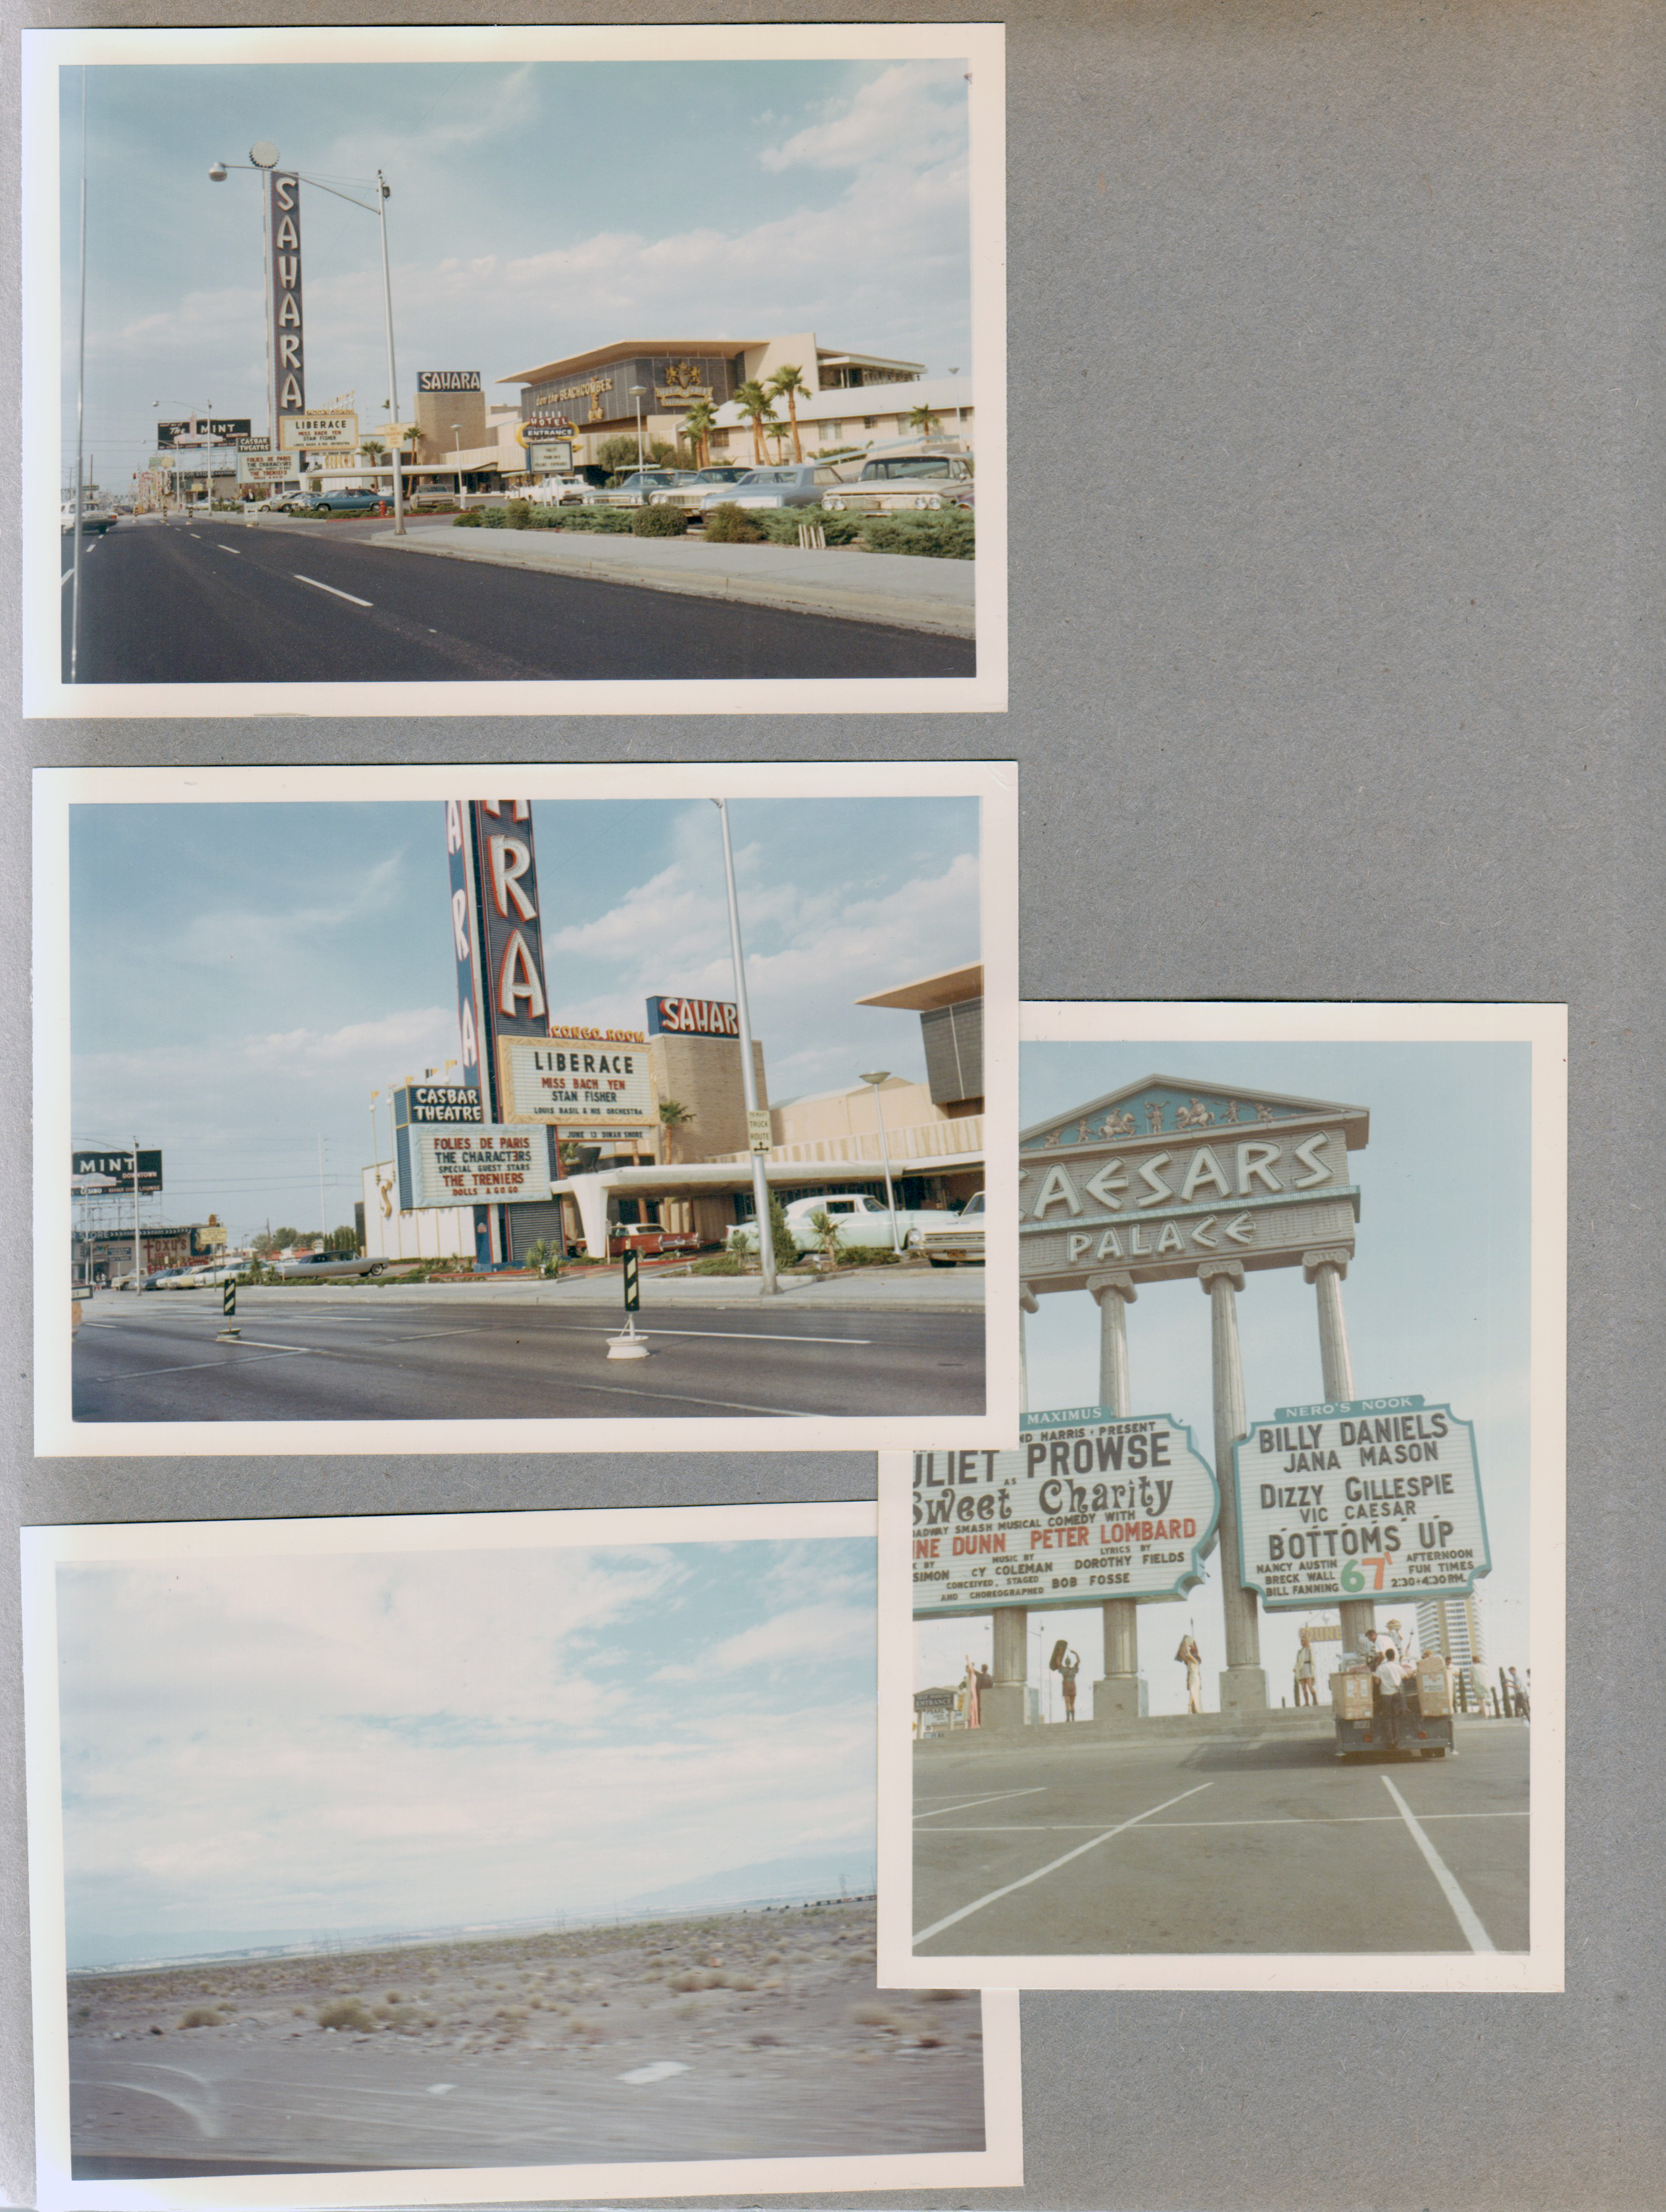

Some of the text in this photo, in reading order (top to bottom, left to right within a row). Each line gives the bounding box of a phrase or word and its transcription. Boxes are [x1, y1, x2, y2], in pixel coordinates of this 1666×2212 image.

[275, 177, 303, 409] SAHARA
[421, 372, 480, 390] SAHARA
[560, 378, 612, 401] BEACHCOMBER
[201, 424, 235, 433] MINT
[296, 420, 346, 429] LIBERACE
[531, 417, 567, 426] HOTEL
[551, 1025, 645, 1043] CONGO ROOM
[535, 1052, 633, 1074] LIBERACE
[542, 1077, 625, 1090] MISS BACH YEN
[416, 1089, 478, 1104] CASBAR
[552, 1091, 616, 1102] STAN FISHER
[413, 1106, 481, 1121] THEATRE
[434, 1137, 529, 1150] FOLIES DE PARIS
[80, 1158, 135, 1173] MINT
[435, 1152, 456, 1164] THE
[439, 1165, 472, 1173] SPECIAL
[1019, 1130, 1335, 1221] AESARS
[443, 1173, 524, 1187] THE TRENIERS
[1067, 1211, 1256, 1263] PALACE
[1286, 1396, 1413, 1417] NERO'S NOOK
[1027, 1408, 1102, 1425] MAXIMUS
[1041, 1428, 1085, 1442] HARRIS
[1099, 1421, 1156, 1436] PRESENT
[1260, 1413, 1448, 1454] BILLY DANIELS
[1027, 1431, 1171, 1479] PROWSE
[1284, 1440, 1438, 1473] JANA MASON
[1039, 1475, 1173, 1517] Charity
[1260, 1473, 1454, 1509] DIZZY GILLESPIE
[1300, 1500, 1416, 1523] VIC CAESAR
[913, 1510, 1135, 1537] ADWAY SMASH MUSICAL COMEDY WITH
[952, 1533, 1006, 1556] DUNN
[1030, 1526, 1089, 1550] PETER
[1100, 1518, 1196, 1544] LOMBARD
[1269, 1521, 1454, 1561] BOTTOMS UP
[1100, 1546, 1131, 1555] LYRICS
[1406, 1549, 1473, 1562] AFTERNOON
[992, 1555, 1017, 1563] MUSIC
[1075, 1552, 1185, 1569] DOROTHY FIELDS
[971, 1561, 1053, 1577] CY COLEMAN
[1256, 1560, 1337, 1574] NANCY AUSTIN
[1409, 1561, 1474, 1574] FUN TIMES
[913, 1570, 950, 1583] SIMON
[1006, 1576, 1039, 1585] STAGED
[1052, 1573, 1130, 1589] BOB FOSSE
[1265, 1571, 1336, 1585] BRECK WALL
[970, 1586, 1044, 1599] CHOREOGRAPHED
[1266, 1583, 1339, 1597] BILL FANNING
